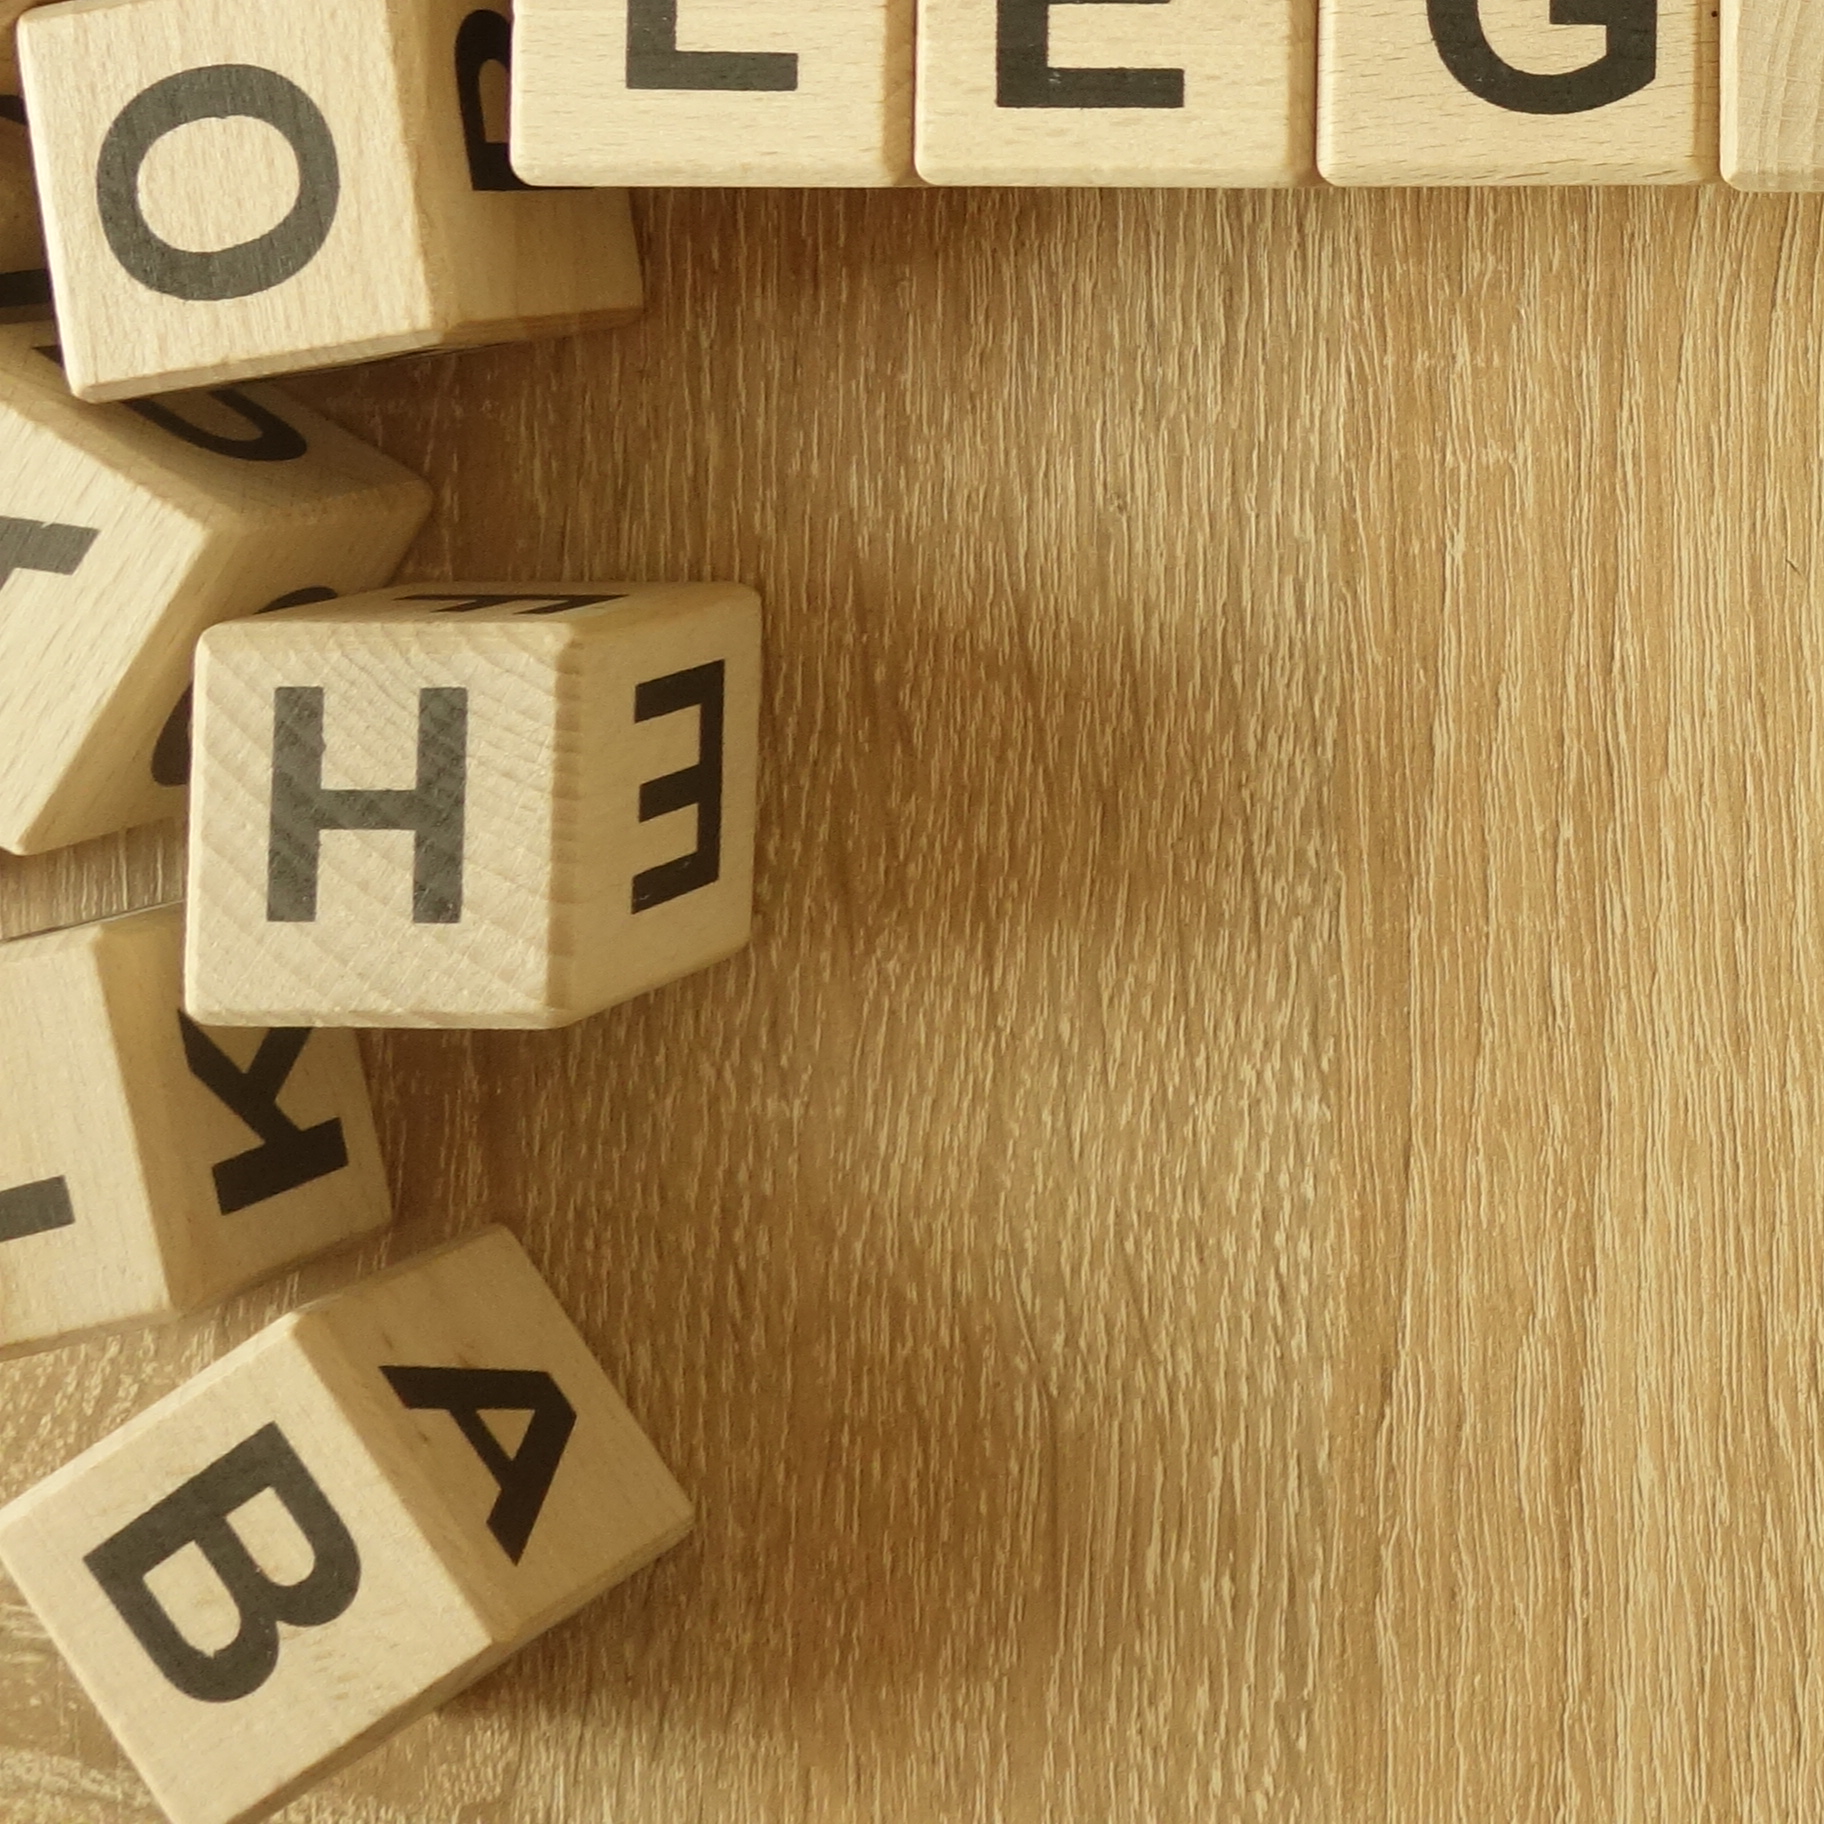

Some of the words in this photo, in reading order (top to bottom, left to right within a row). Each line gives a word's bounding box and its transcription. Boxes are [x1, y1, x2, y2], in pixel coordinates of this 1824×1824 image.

[96, 63, 340, 302] O
[266, 686, 468, 924] H
[631, 659, 725, 914] E
[177, 1009, 349, 1216] K
[83, 1421, 361, 1703] B
[379, 1364, 577, 1566] A
